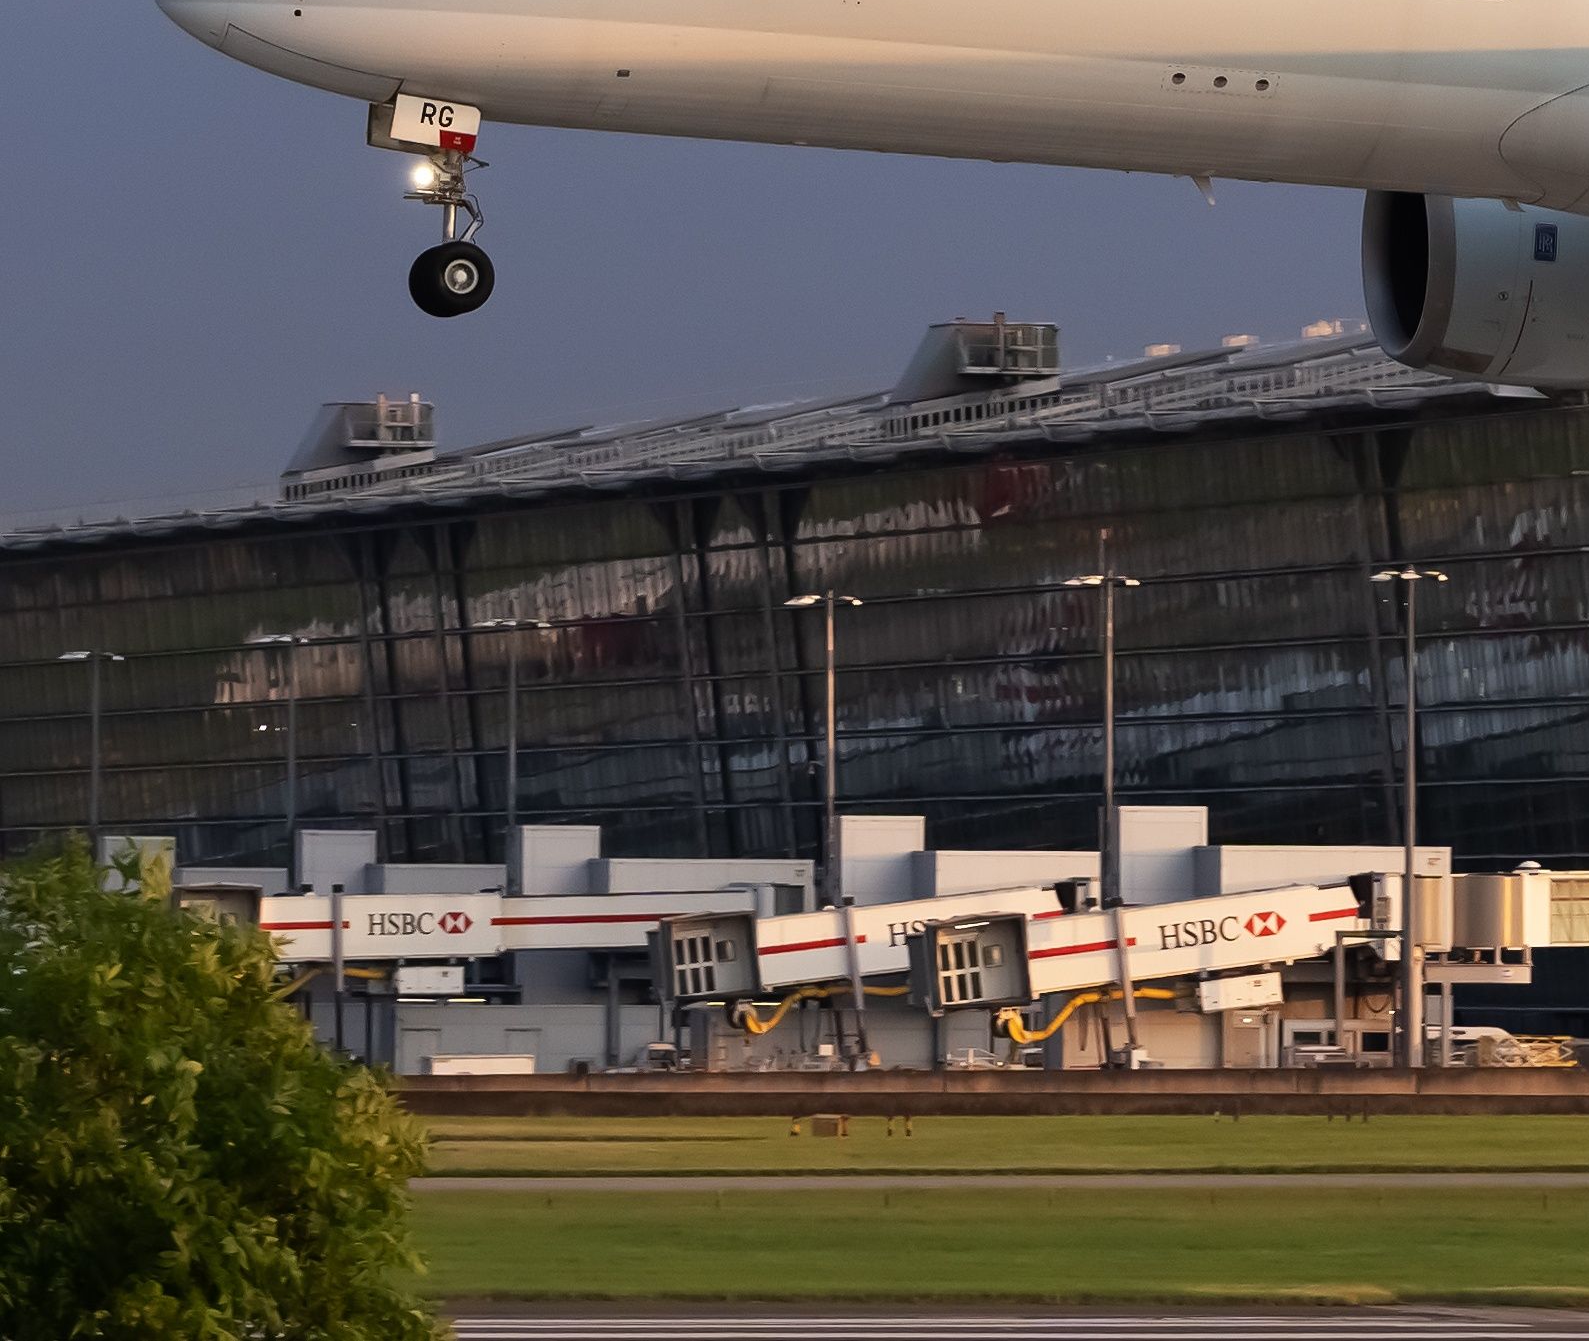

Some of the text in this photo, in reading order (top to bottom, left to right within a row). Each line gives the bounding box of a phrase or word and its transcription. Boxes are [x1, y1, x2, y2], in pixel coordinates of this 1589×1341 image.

[420, 102, 455, 128] RG
[367, 912, 435, 936] HSBC
[1157, 915, 1240, 951] HSBC
